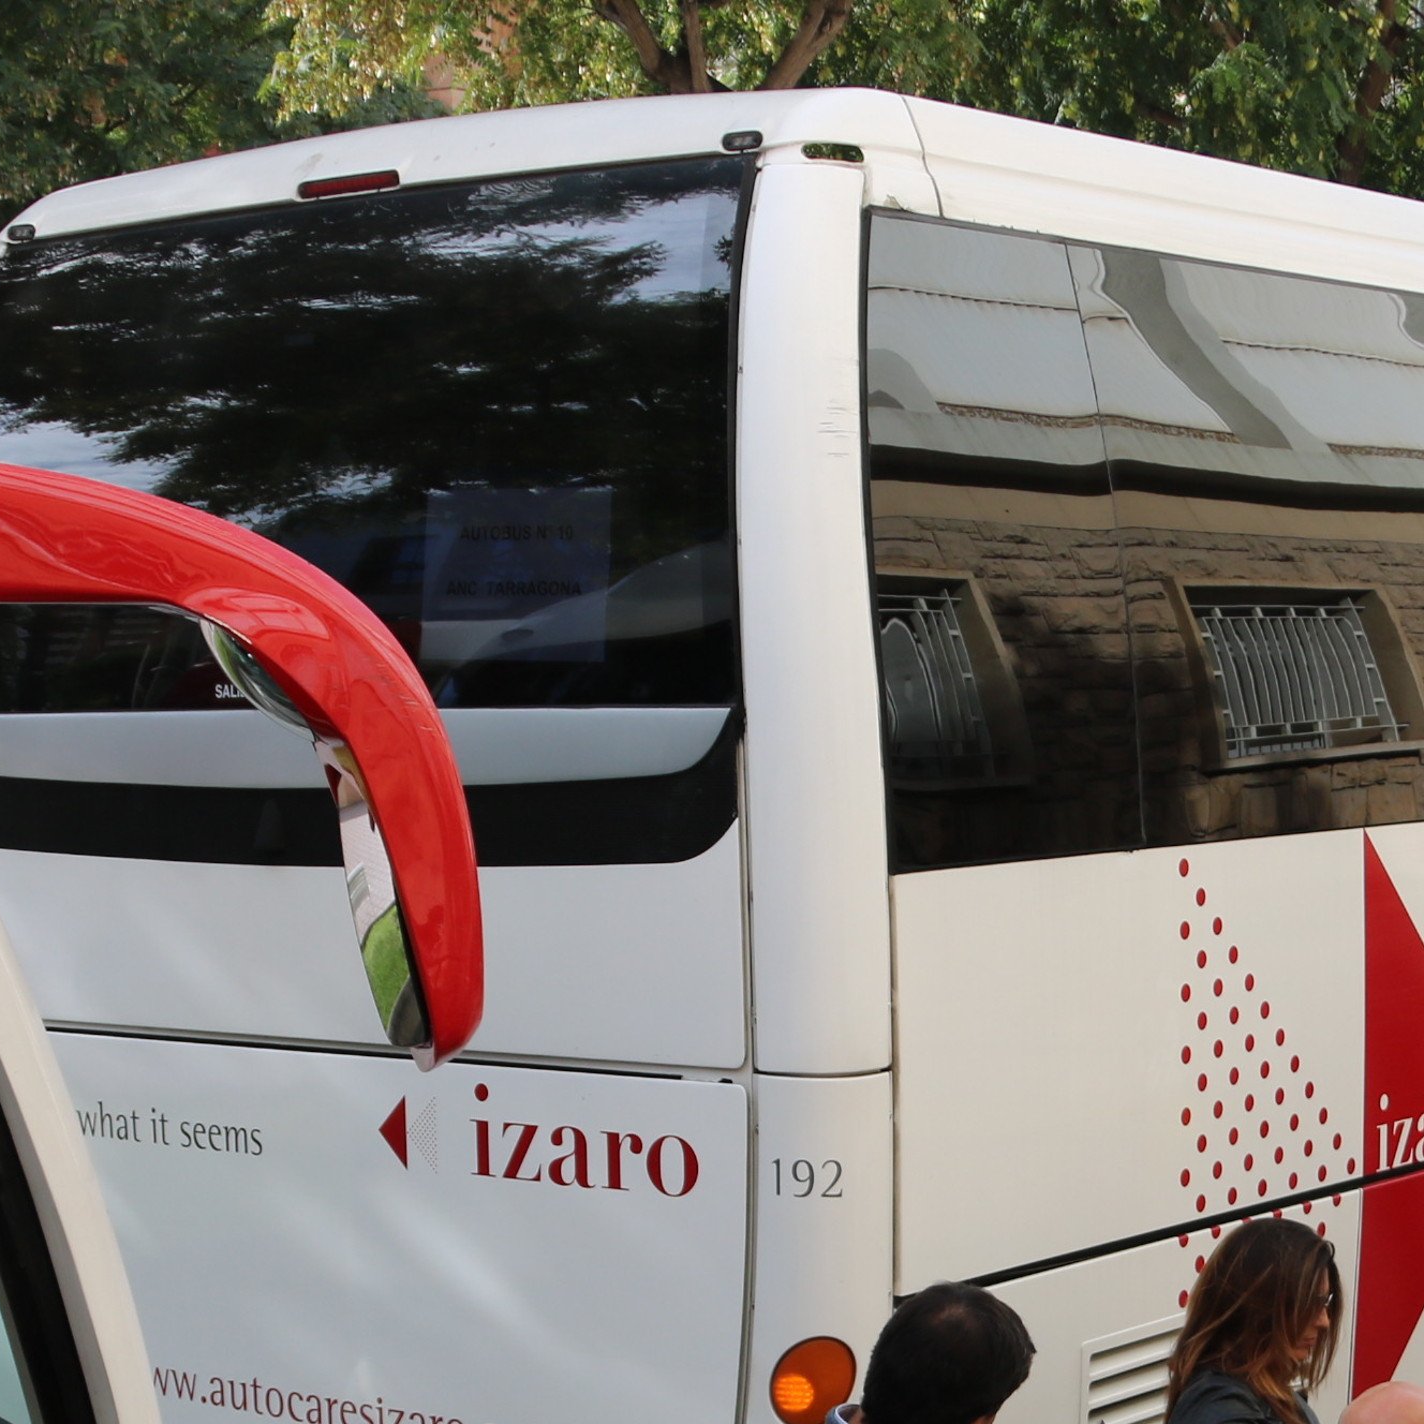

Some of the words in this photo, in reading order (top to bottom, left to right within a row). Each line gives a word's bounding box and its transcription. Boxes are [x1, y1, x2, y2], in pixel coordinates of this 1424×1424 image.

[460, 525, 533, 541] AUTOBUS
[558, 525, 573, 541] 10
[447, 581, 477, 596] ANC
[487, 581, 582, 596] TARRAGONA
[76, 1101, 141, 1143] what
[151, 1107, 169, 1145] it
[180, 1121, 263, 1156] seems
[470, 1083, 700, 1198] izaro
[771, 1158, 844, 1199] 192
